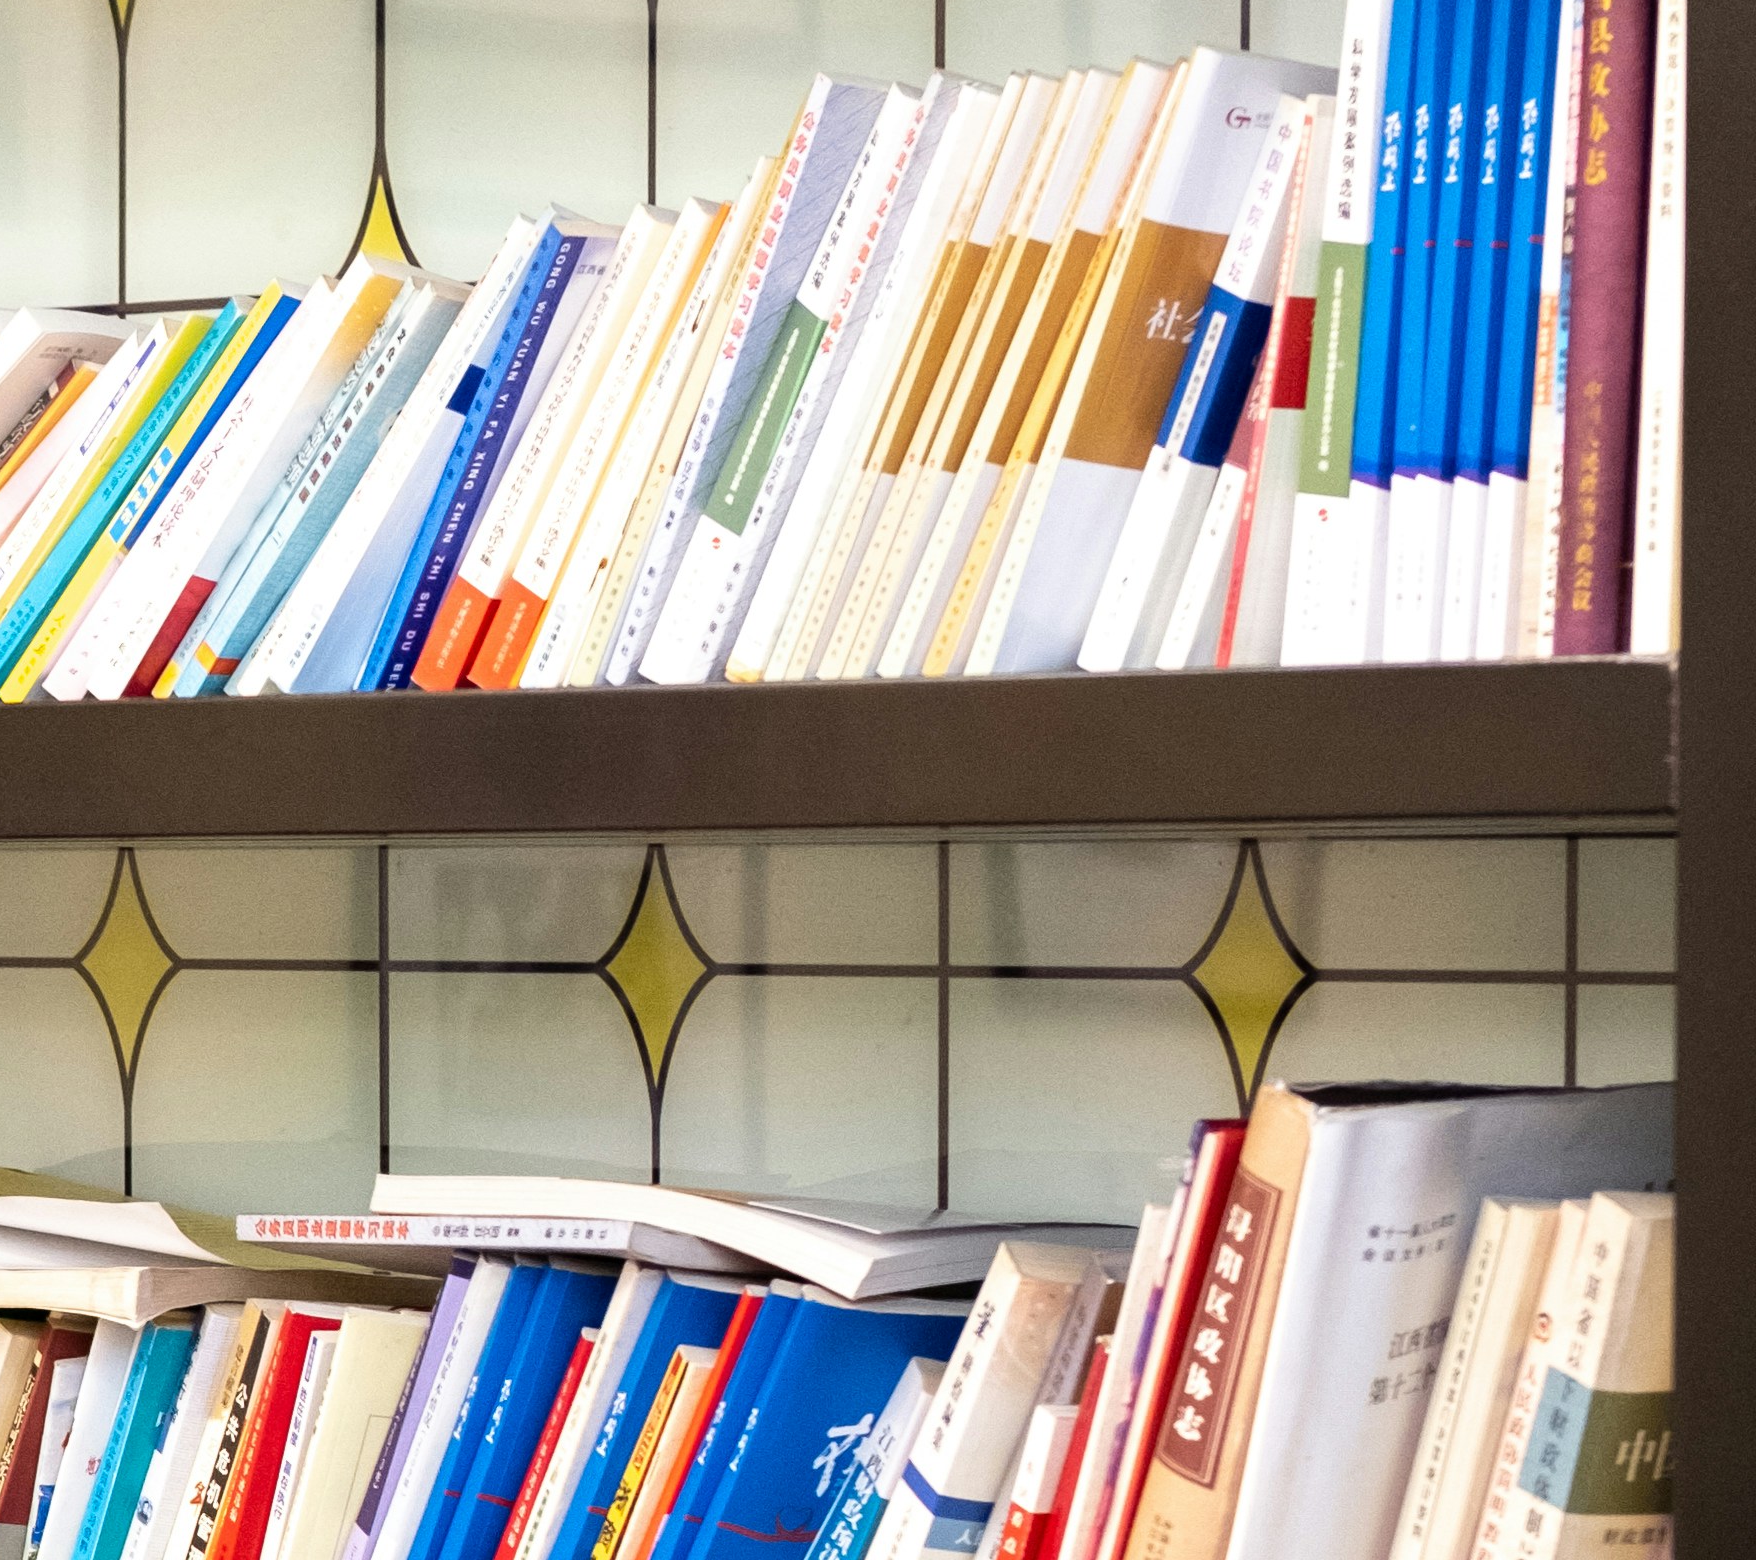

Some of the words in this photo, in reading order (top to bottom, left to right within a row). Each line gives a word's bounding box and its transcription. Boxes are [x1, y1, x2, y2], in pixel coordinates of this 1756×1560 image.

[723, 111, 816, 361] 公务员职业道德学习读本
[545, 241, 571, 290] GONG
[529, 298, 547, 326] WU
[506, 335, 532, 382] YUAN
[495, 391, 509, 409] YI
[482, 418, 498, 441] FA
[462, 449, 486, 492] XING
[442, 500, 466, 544] ZHEN
[426, 552, 445, 582] ZHI
[411, 589, 431, 620] SHI
[400, 628, 416, 652] DU
[384, 660, 403, 695] BEN
[254, 1219, 410, 1240] 公务员职业道德学习读本
[1170, 1203, 1256, 1442] 浔阳区政协志
